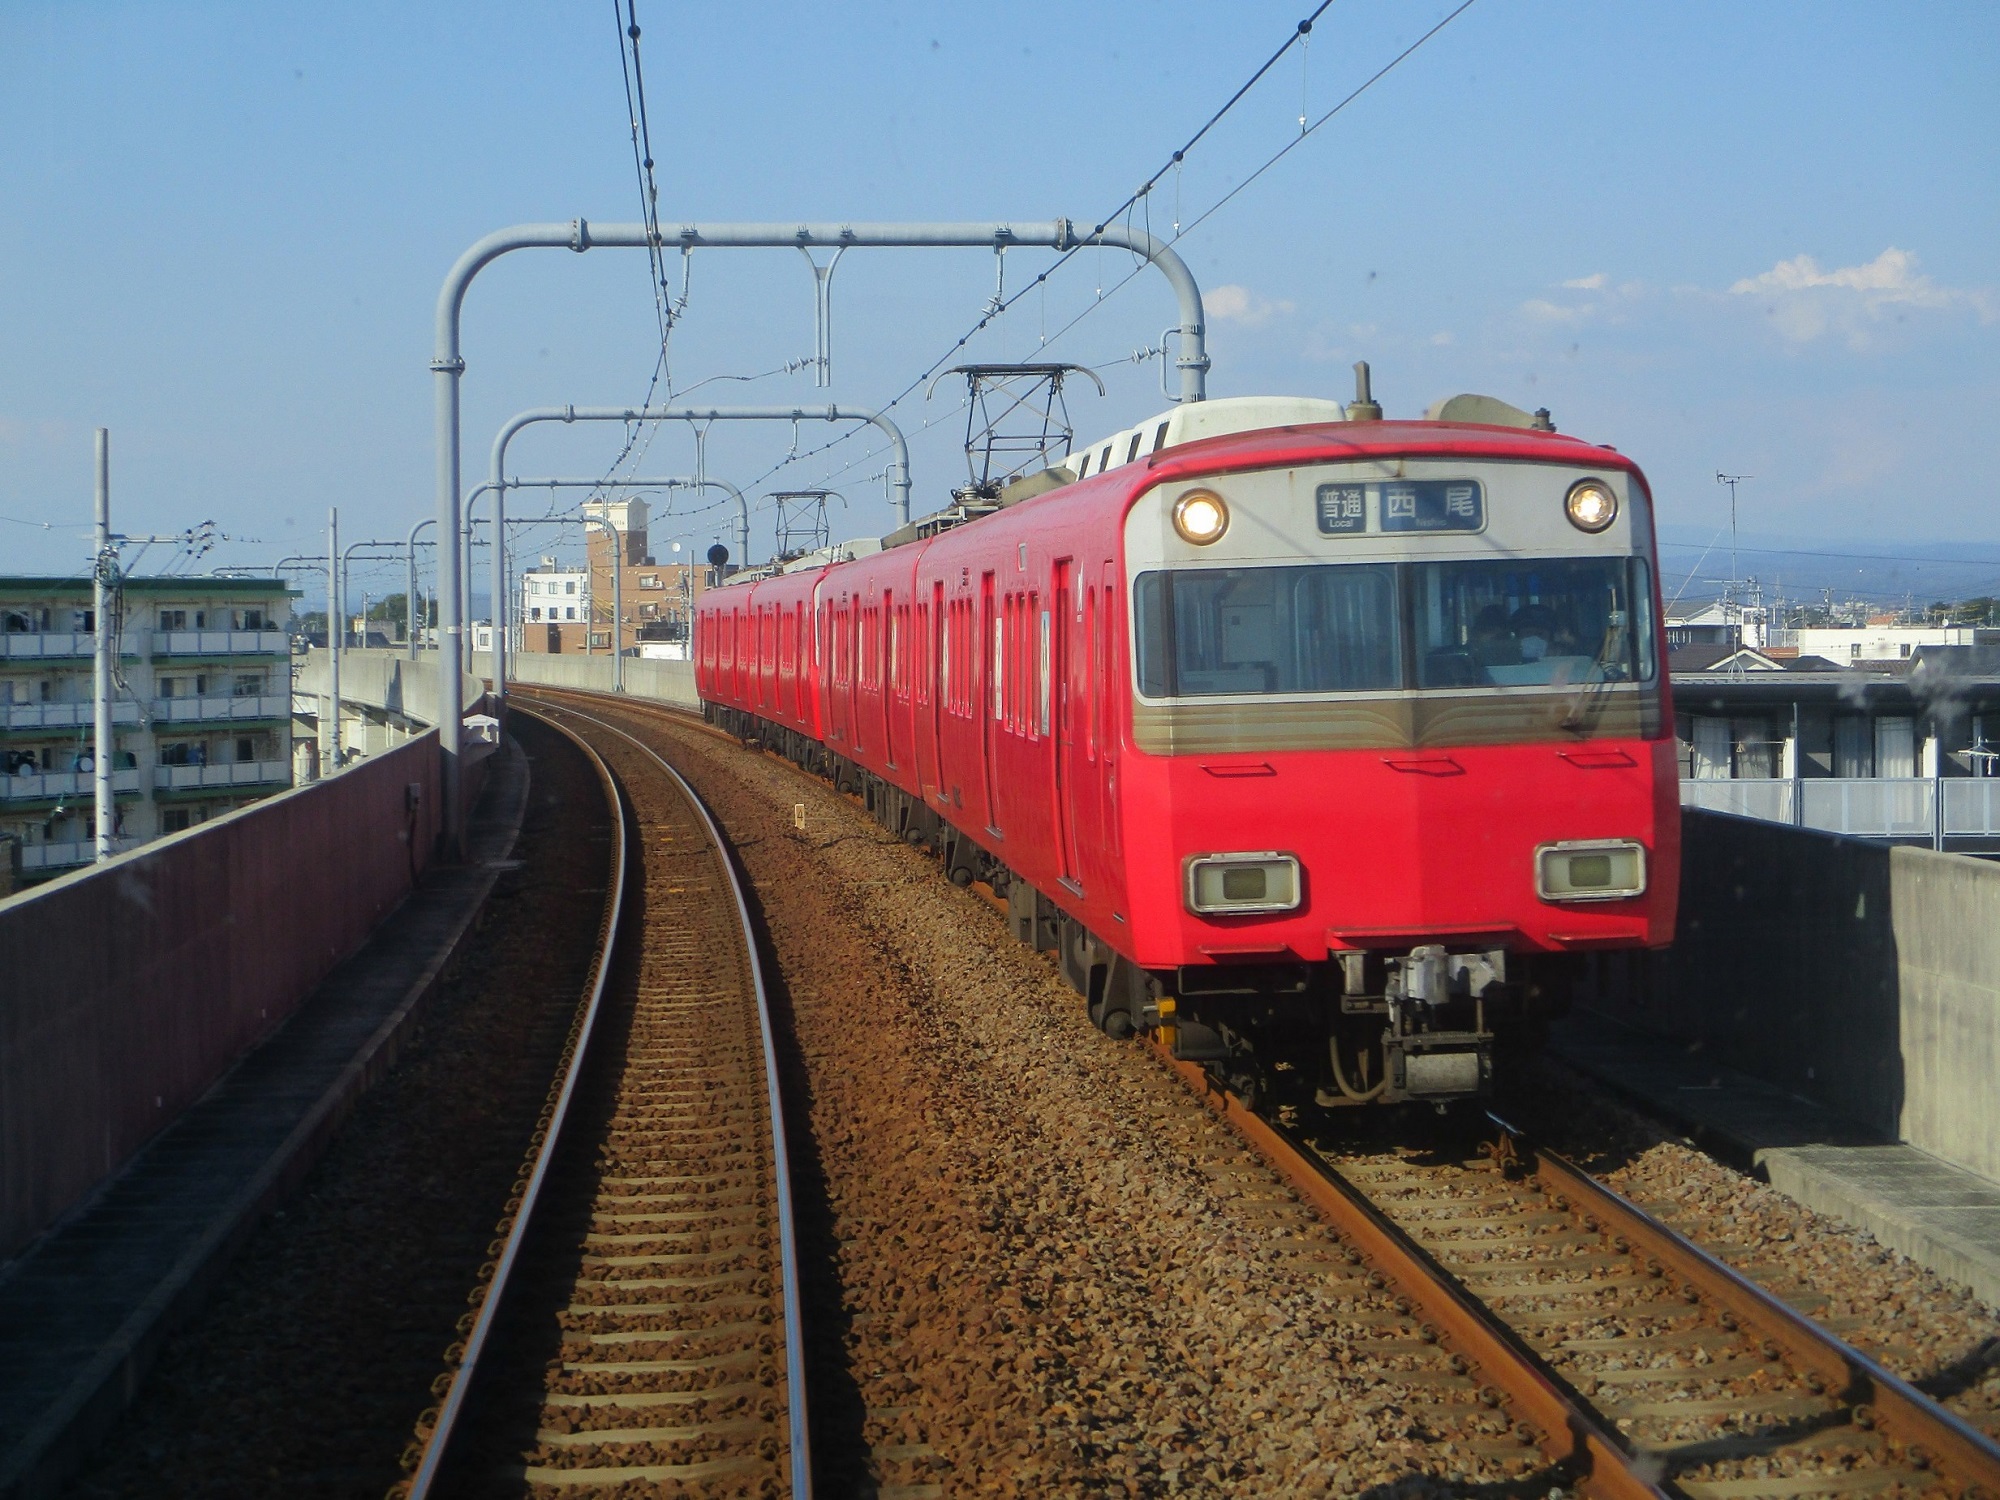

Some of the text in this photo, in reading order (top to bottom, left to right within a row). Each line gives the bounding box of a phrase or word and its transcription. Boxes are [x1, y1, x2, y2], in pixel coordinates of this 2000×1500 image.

[1320, 489, 1362, 518] 普通
[1386, 487, 1475, 518] 西尾
[1329, 519, 1353, 528] Local
